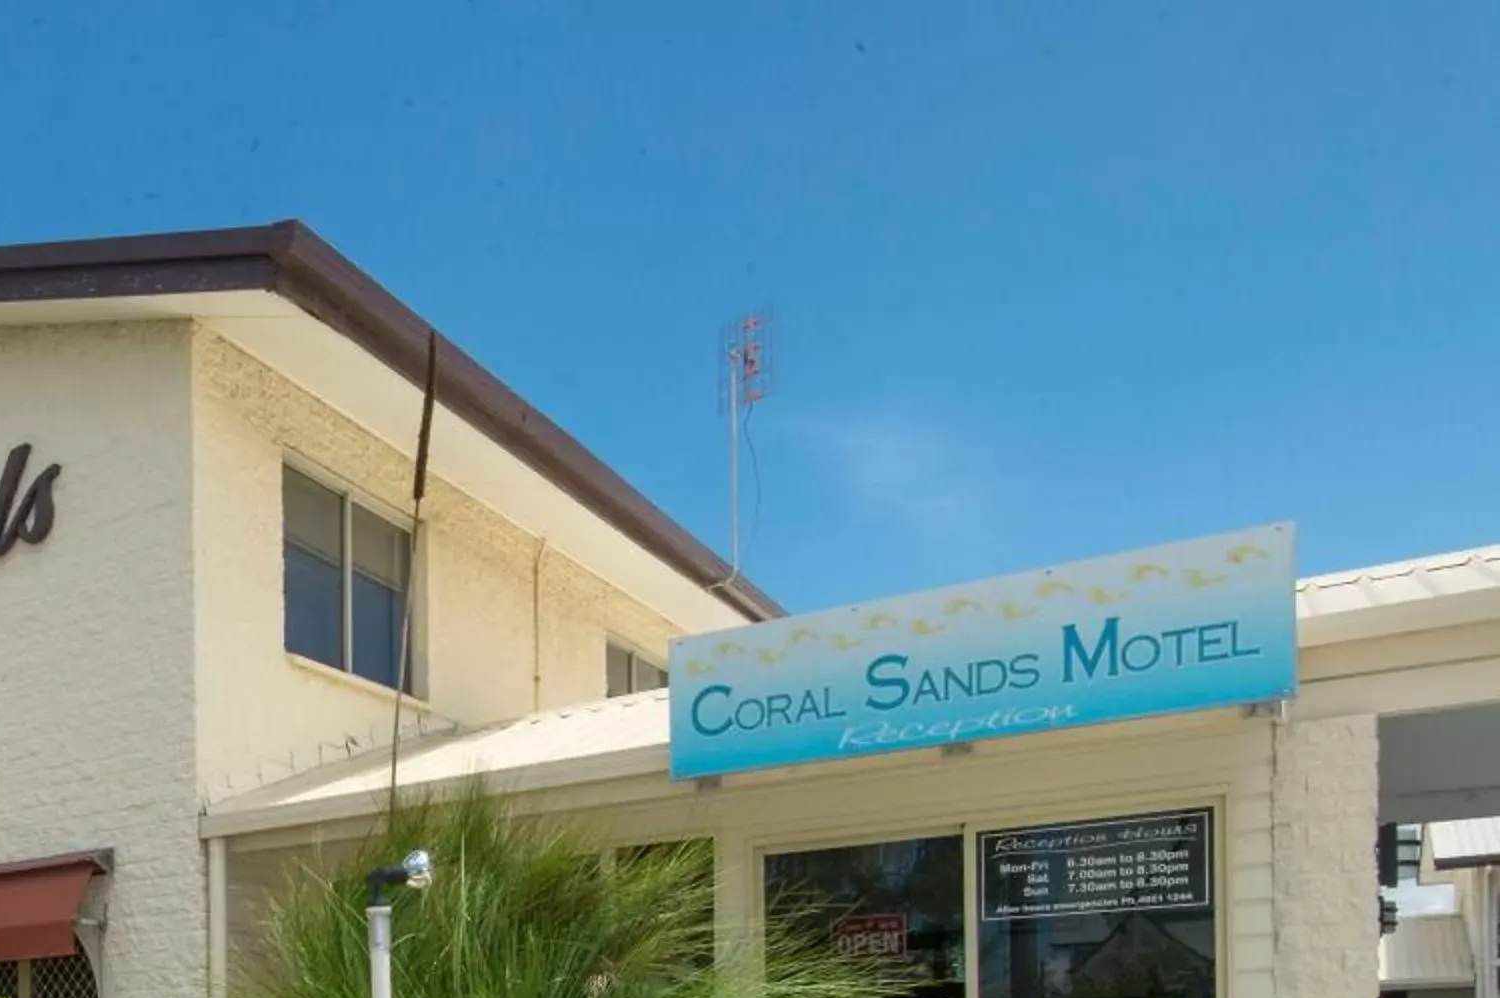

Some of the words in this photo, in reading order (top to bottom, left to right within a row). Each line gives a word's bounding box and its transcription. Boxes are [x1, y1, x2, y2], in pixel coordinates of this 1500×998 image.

[691, 683, 847, 737] CORAL
[864, 654, 1041, 710] SANDS
[1061, 616, 1260, 683] MOTEL
[838, 704, 1080, 749] Reception
[995, 832, 1107, 852] Reception
[1120, 853, 1134, 864] to
[1120, 867, 1134, 877] to
[1120, 879, 1134, 890] to
[837, 931, 900, 957] OPEN
